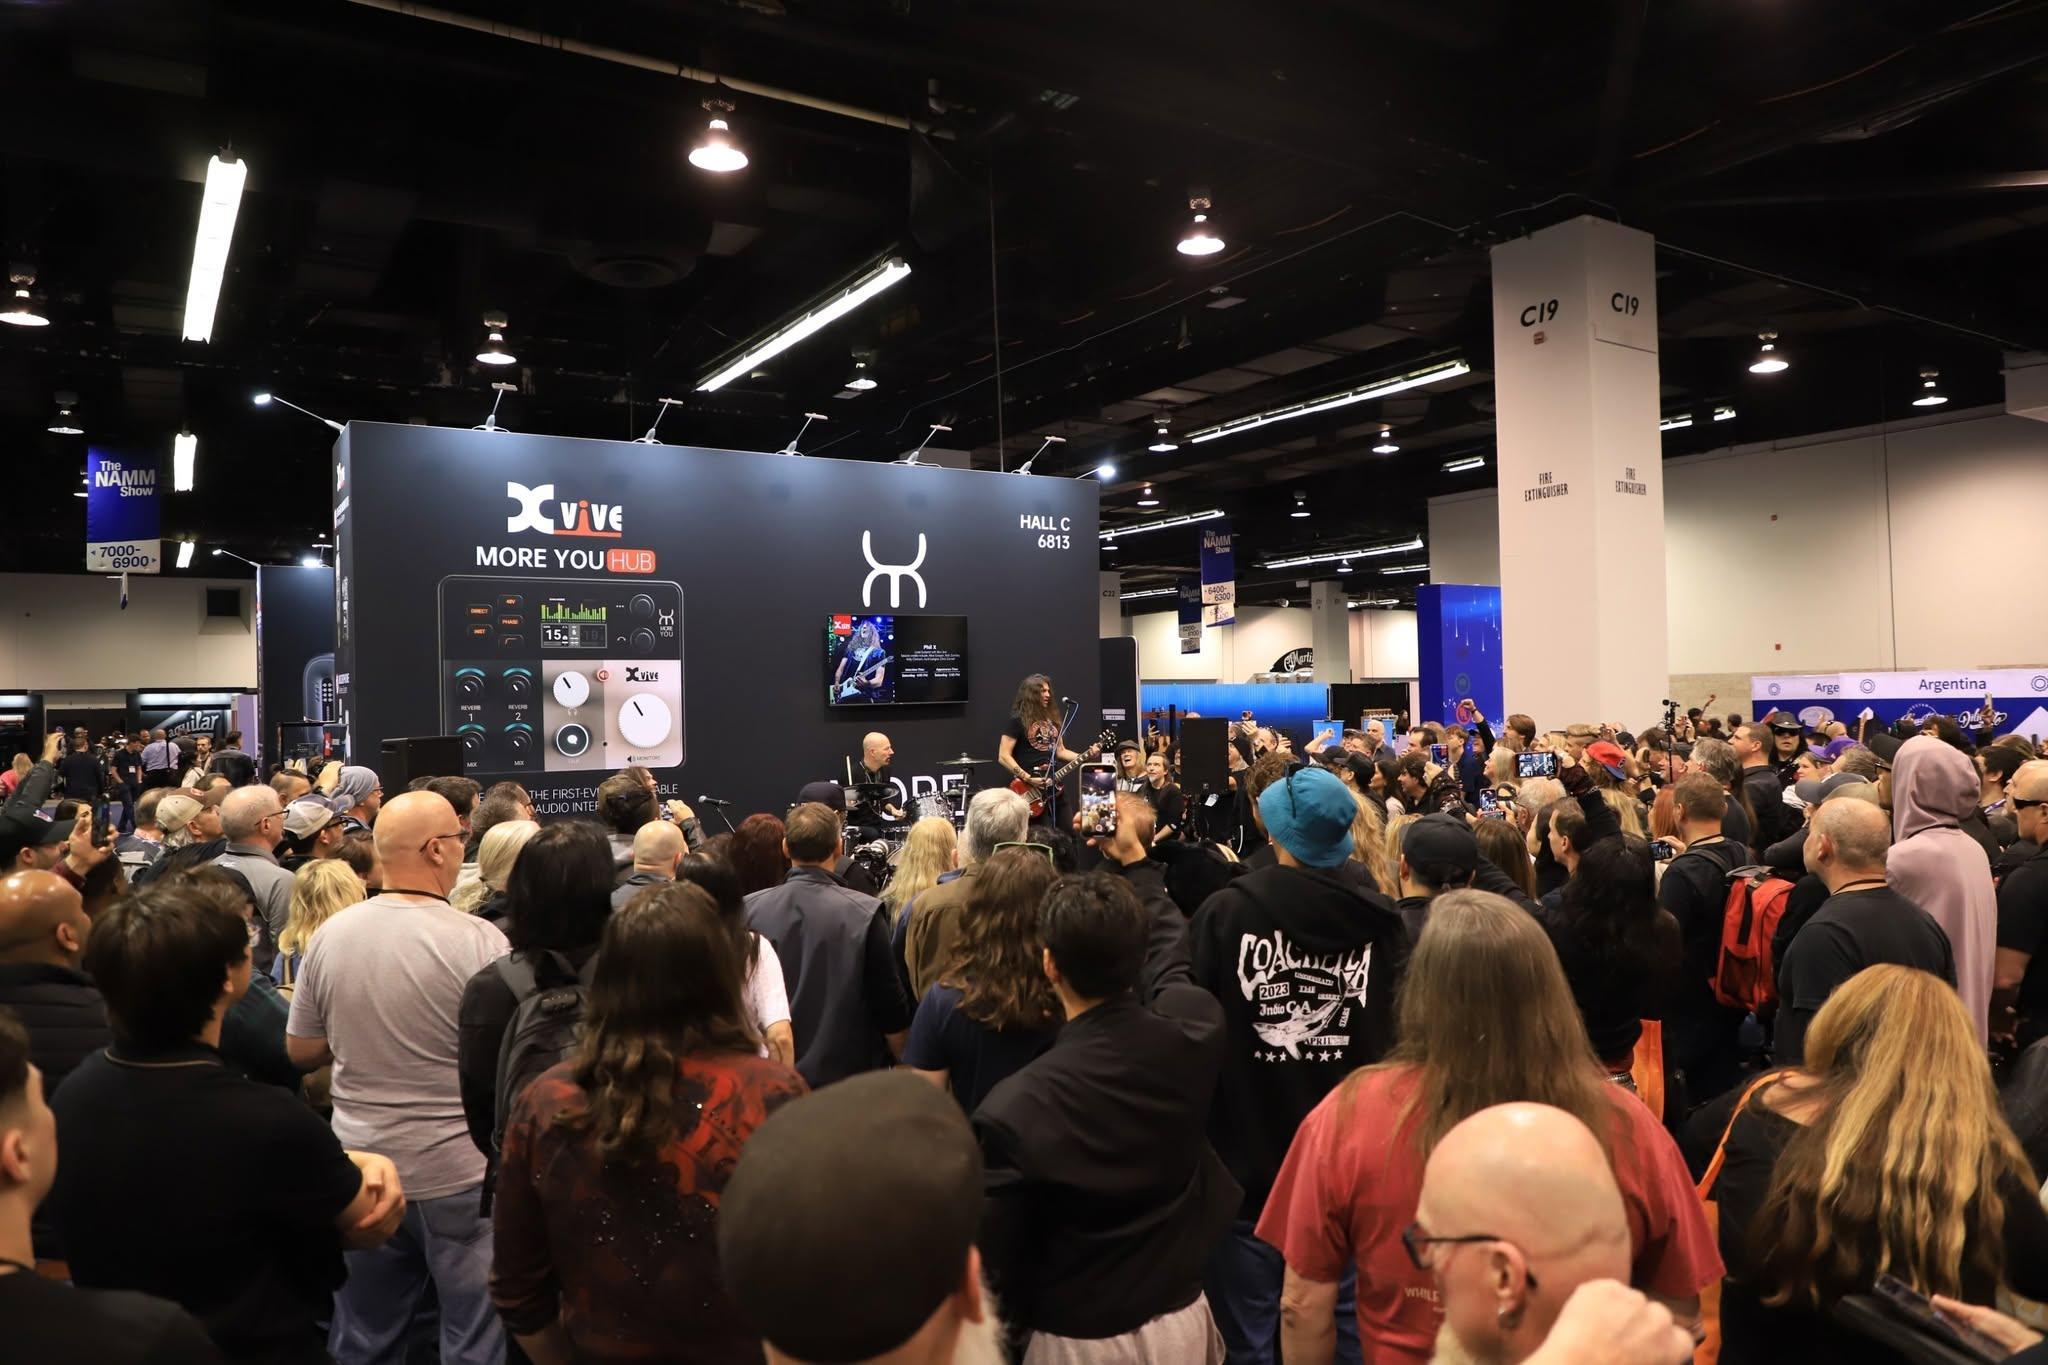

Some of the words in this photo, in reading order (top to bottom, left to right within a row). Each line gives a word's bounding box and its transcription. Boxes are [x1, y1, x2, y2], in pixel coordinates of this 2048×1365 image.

[1611, 293, 1639, 316] C19
[1520, 299, 1559, 327] C19
[99, 461, 121, 471] The
[95, 470, 155, 487] NAMM
[1539, 472, 1552, 484] FIRE
[1625, 467, 1636, 480] FIRE
[120, 486, 153, 497] Show
[1524, 483, 1568, 502] EXTINGUISHER
[1615, 480, 1647, 496] EXTINGUISHER
[1020, 514, 1057, 531] HALL
[1060, 516, 1070, 531] C
[1038, 534, 1070, 550] 6813
[1203, 535, 1231, 548] NAMM
[99, 545, 141, 557] 7000-
[112, 556, 149, 568] 6900
[475, 546, 547, 568] MORE
[553, 549, 605, 570] YOU
[611, 551, 652, 571] HUB
[1214, 592, 1231, 602] 6300
[1919, 677, 1987, 694] Argentina
[468, 713, 473, 722] 1
[515, 712, 521, 721] 2
[529, 789, 549, 801] THE
[552, 788, 600, 799] FIRST-EV
[535, 802, 570, 814] AUDIO
[1260, 983, 1288, 999] 2023
[1404, 1287, 1438, 1302] WHILE
